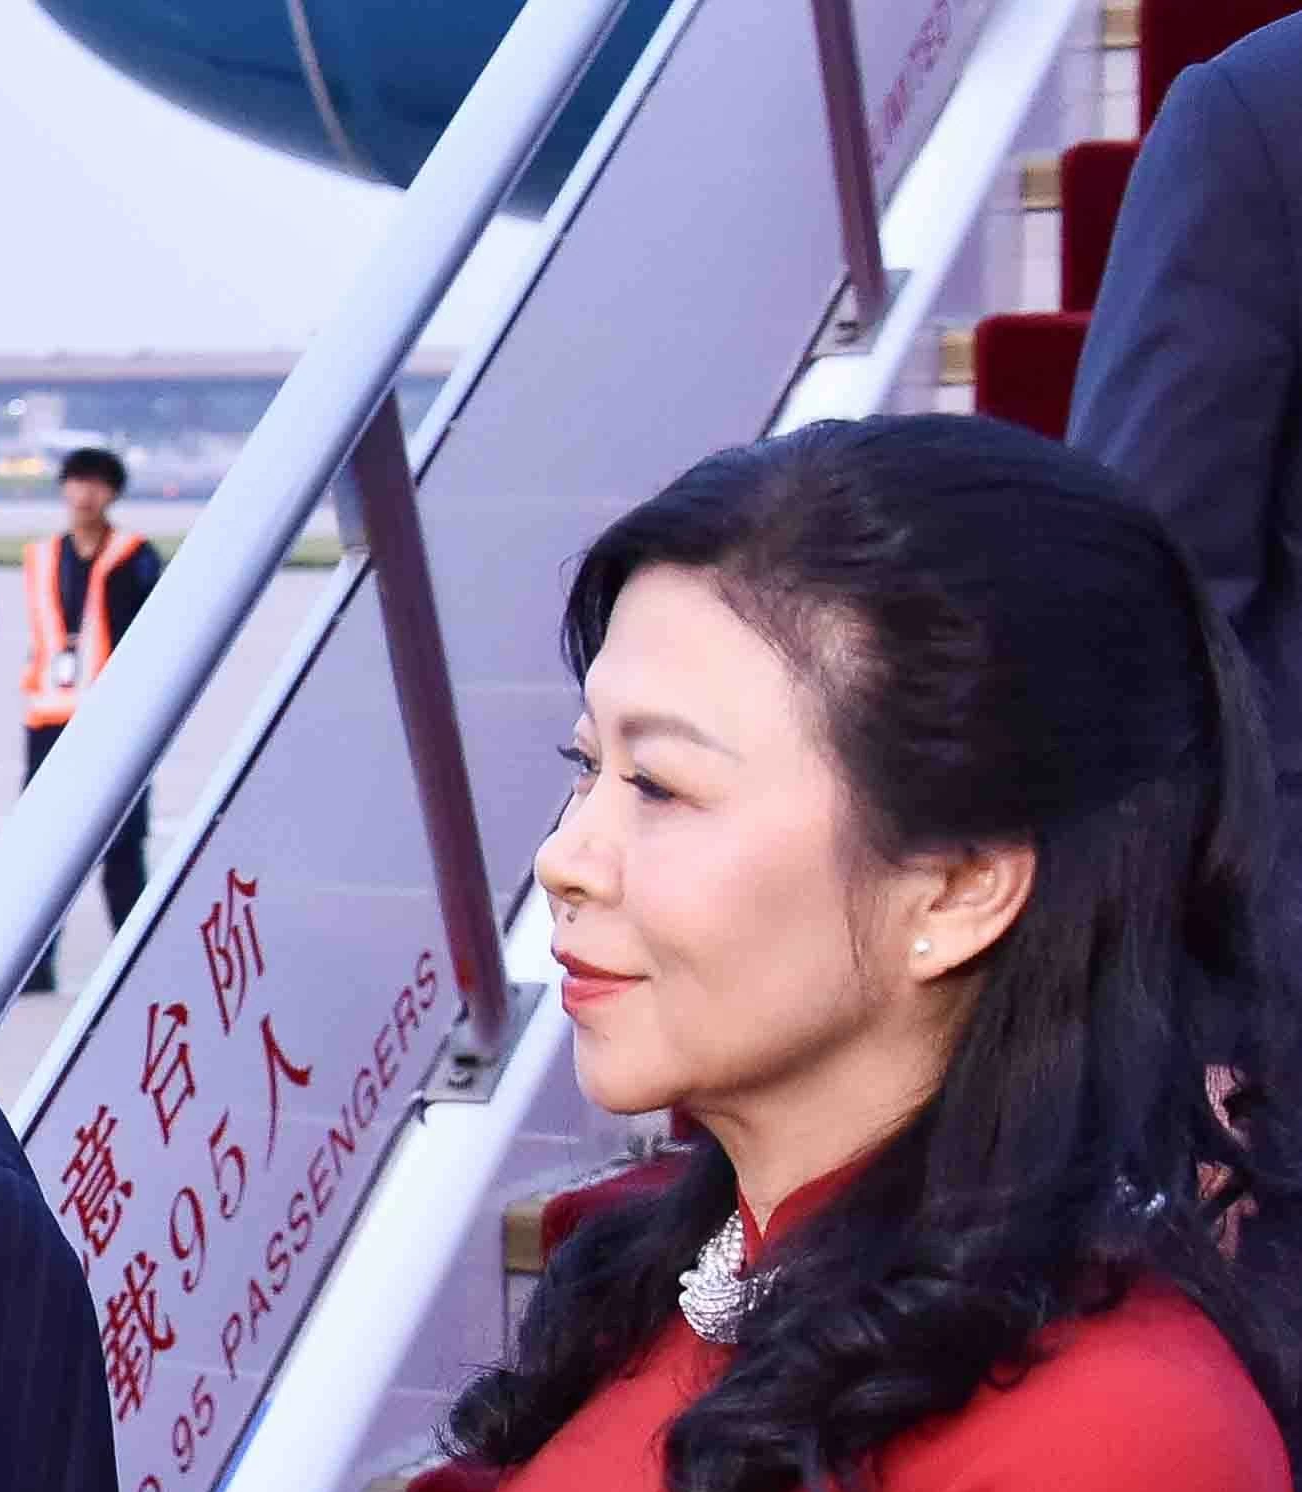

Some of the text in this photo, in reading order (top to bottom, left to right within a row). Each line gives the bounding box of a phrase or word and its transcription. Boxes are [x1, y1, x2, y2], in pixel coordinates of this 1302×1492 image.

[61, 867, 264, 1272] 意台阶
[172, 1374, 214, 1473] 95
[221, 951, 438, 1381] PASSENGERS
